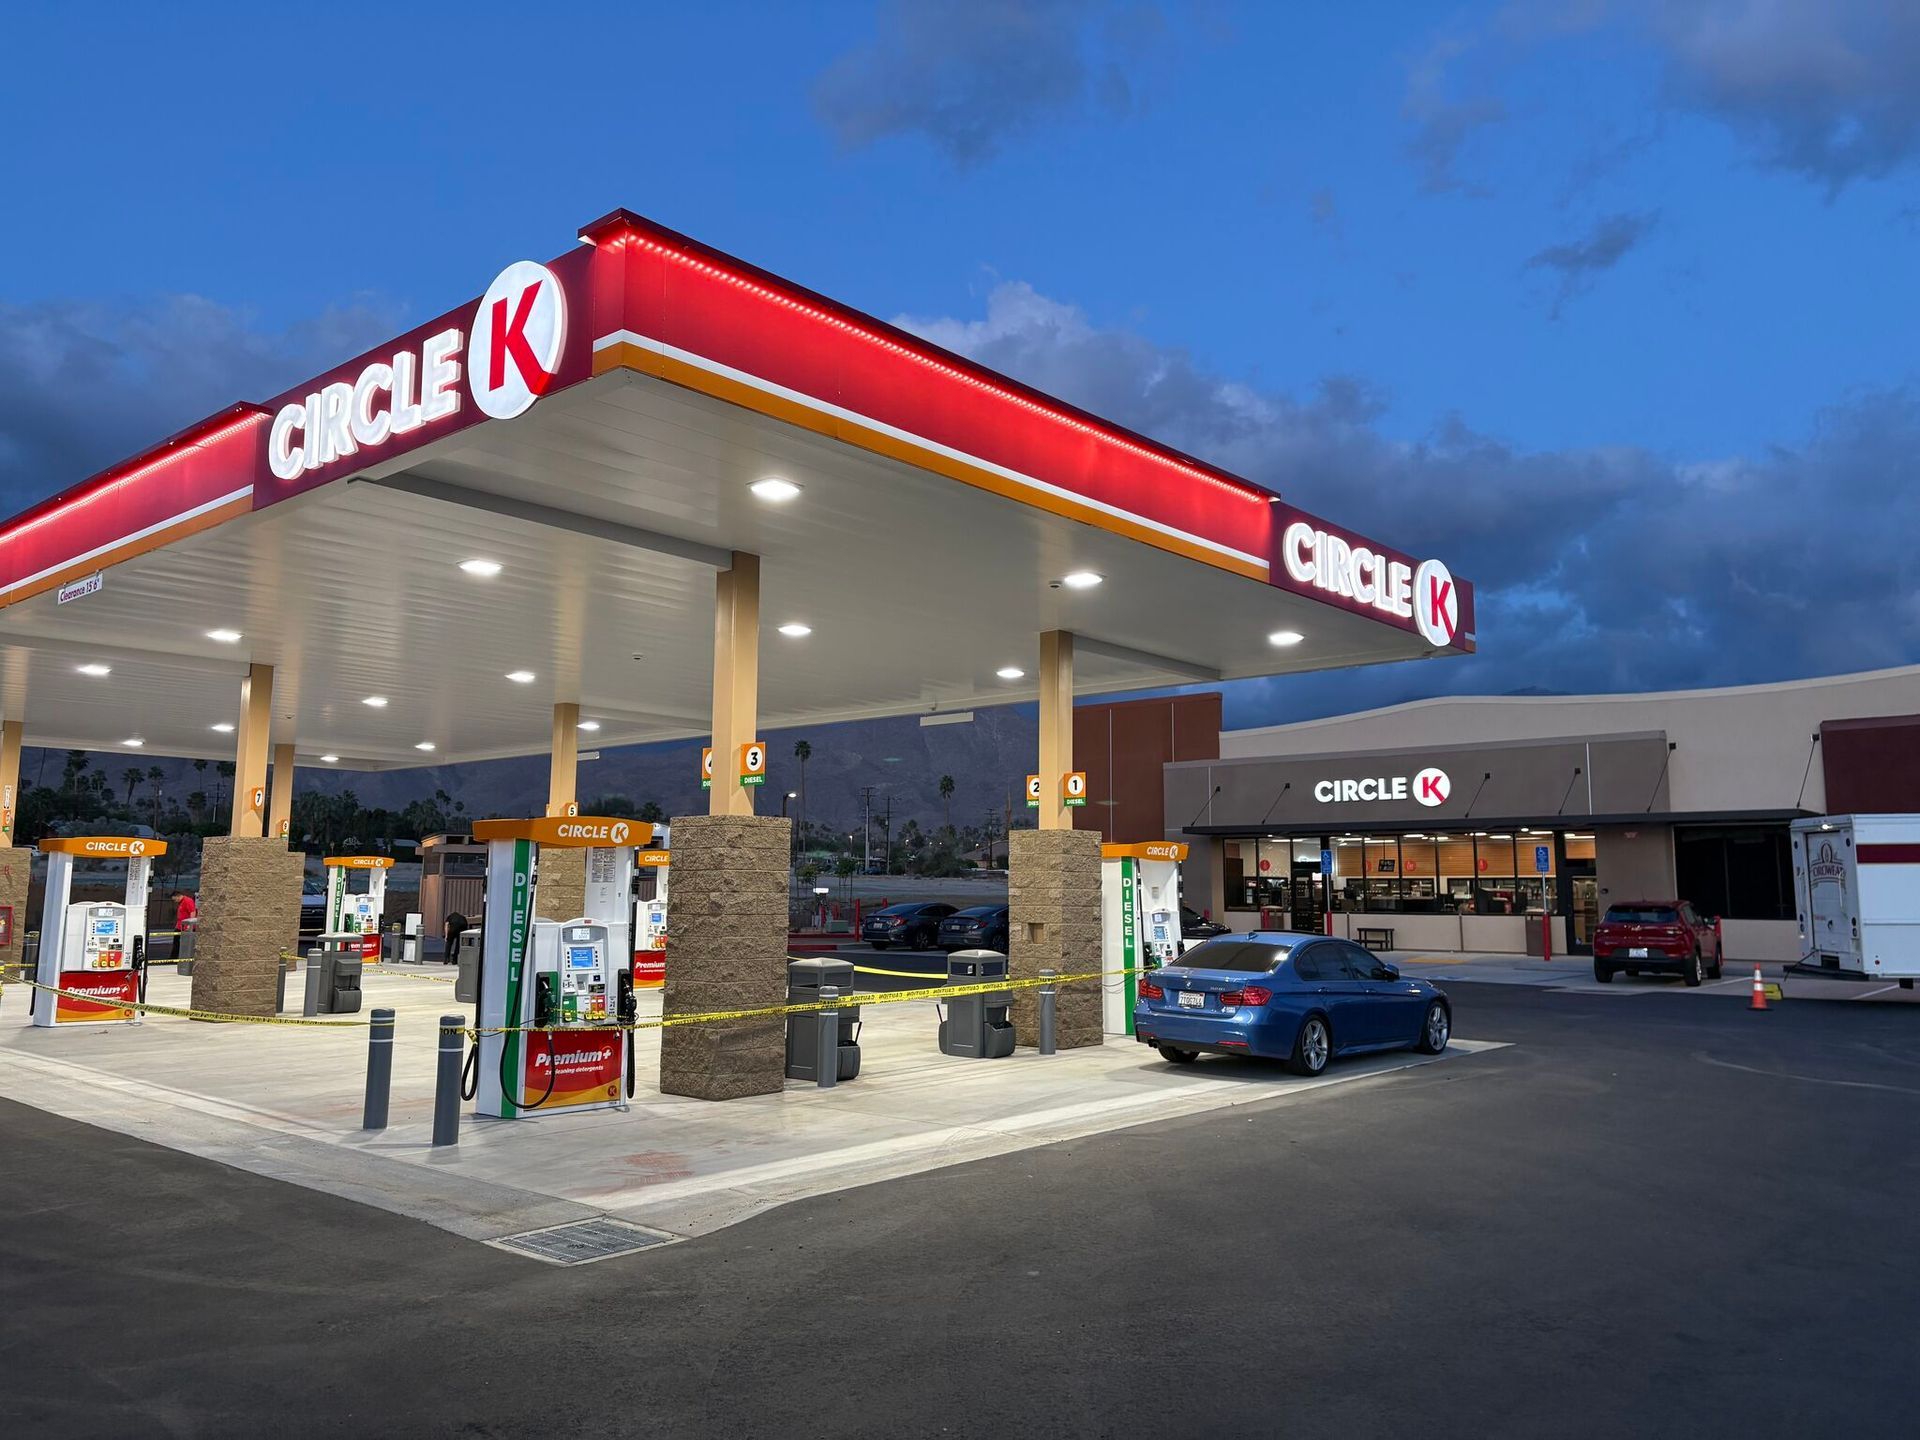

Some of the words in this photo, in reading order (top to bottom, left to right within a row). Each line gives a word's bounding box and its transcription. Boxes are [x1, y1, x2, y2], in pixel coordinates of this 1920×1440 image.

[268, 328, 465, 481] CIRCLE
[487, 279, 556, 398] K
[1283, 522, 1413, 618] CIRCLE
[1430, 575, 1455, 641] K
[60, 587, 85, 602] Clearance
[750, 752, 758, 766] 3
[744, 776, 762, 784] DIESEL
[1072, 779, 1078, 791] 1
[1033, 781, 1040, 793] 2
[1314, 777, 1408, 803] CIRCLE
[1421, 775, 1446, 802] K
[256, 793, 262, 803] 7
[569, 807, 575, 816] 5
[557, 823, 609, 839] CIRCLE
[613, 824, 629, 843] K
[85, 841, 128, 852] CIRCLE
[130, 841, 144, 854] K
[1146, 846, 1170, 856] CIRCLE
[1170, 846, 1178, 858] K
[644, 855, 668, 863] CIRCLE
[334, 876, 342, 918] DIESEL
[1123, 878, 1134, 949] DIESEL
[510, 872, 527, 982] DIESEL
[635, 960, 666, 969] Premium
[555, 1067, 575, 1075] leaning
[575, 1065, 604, 1073] detergents
